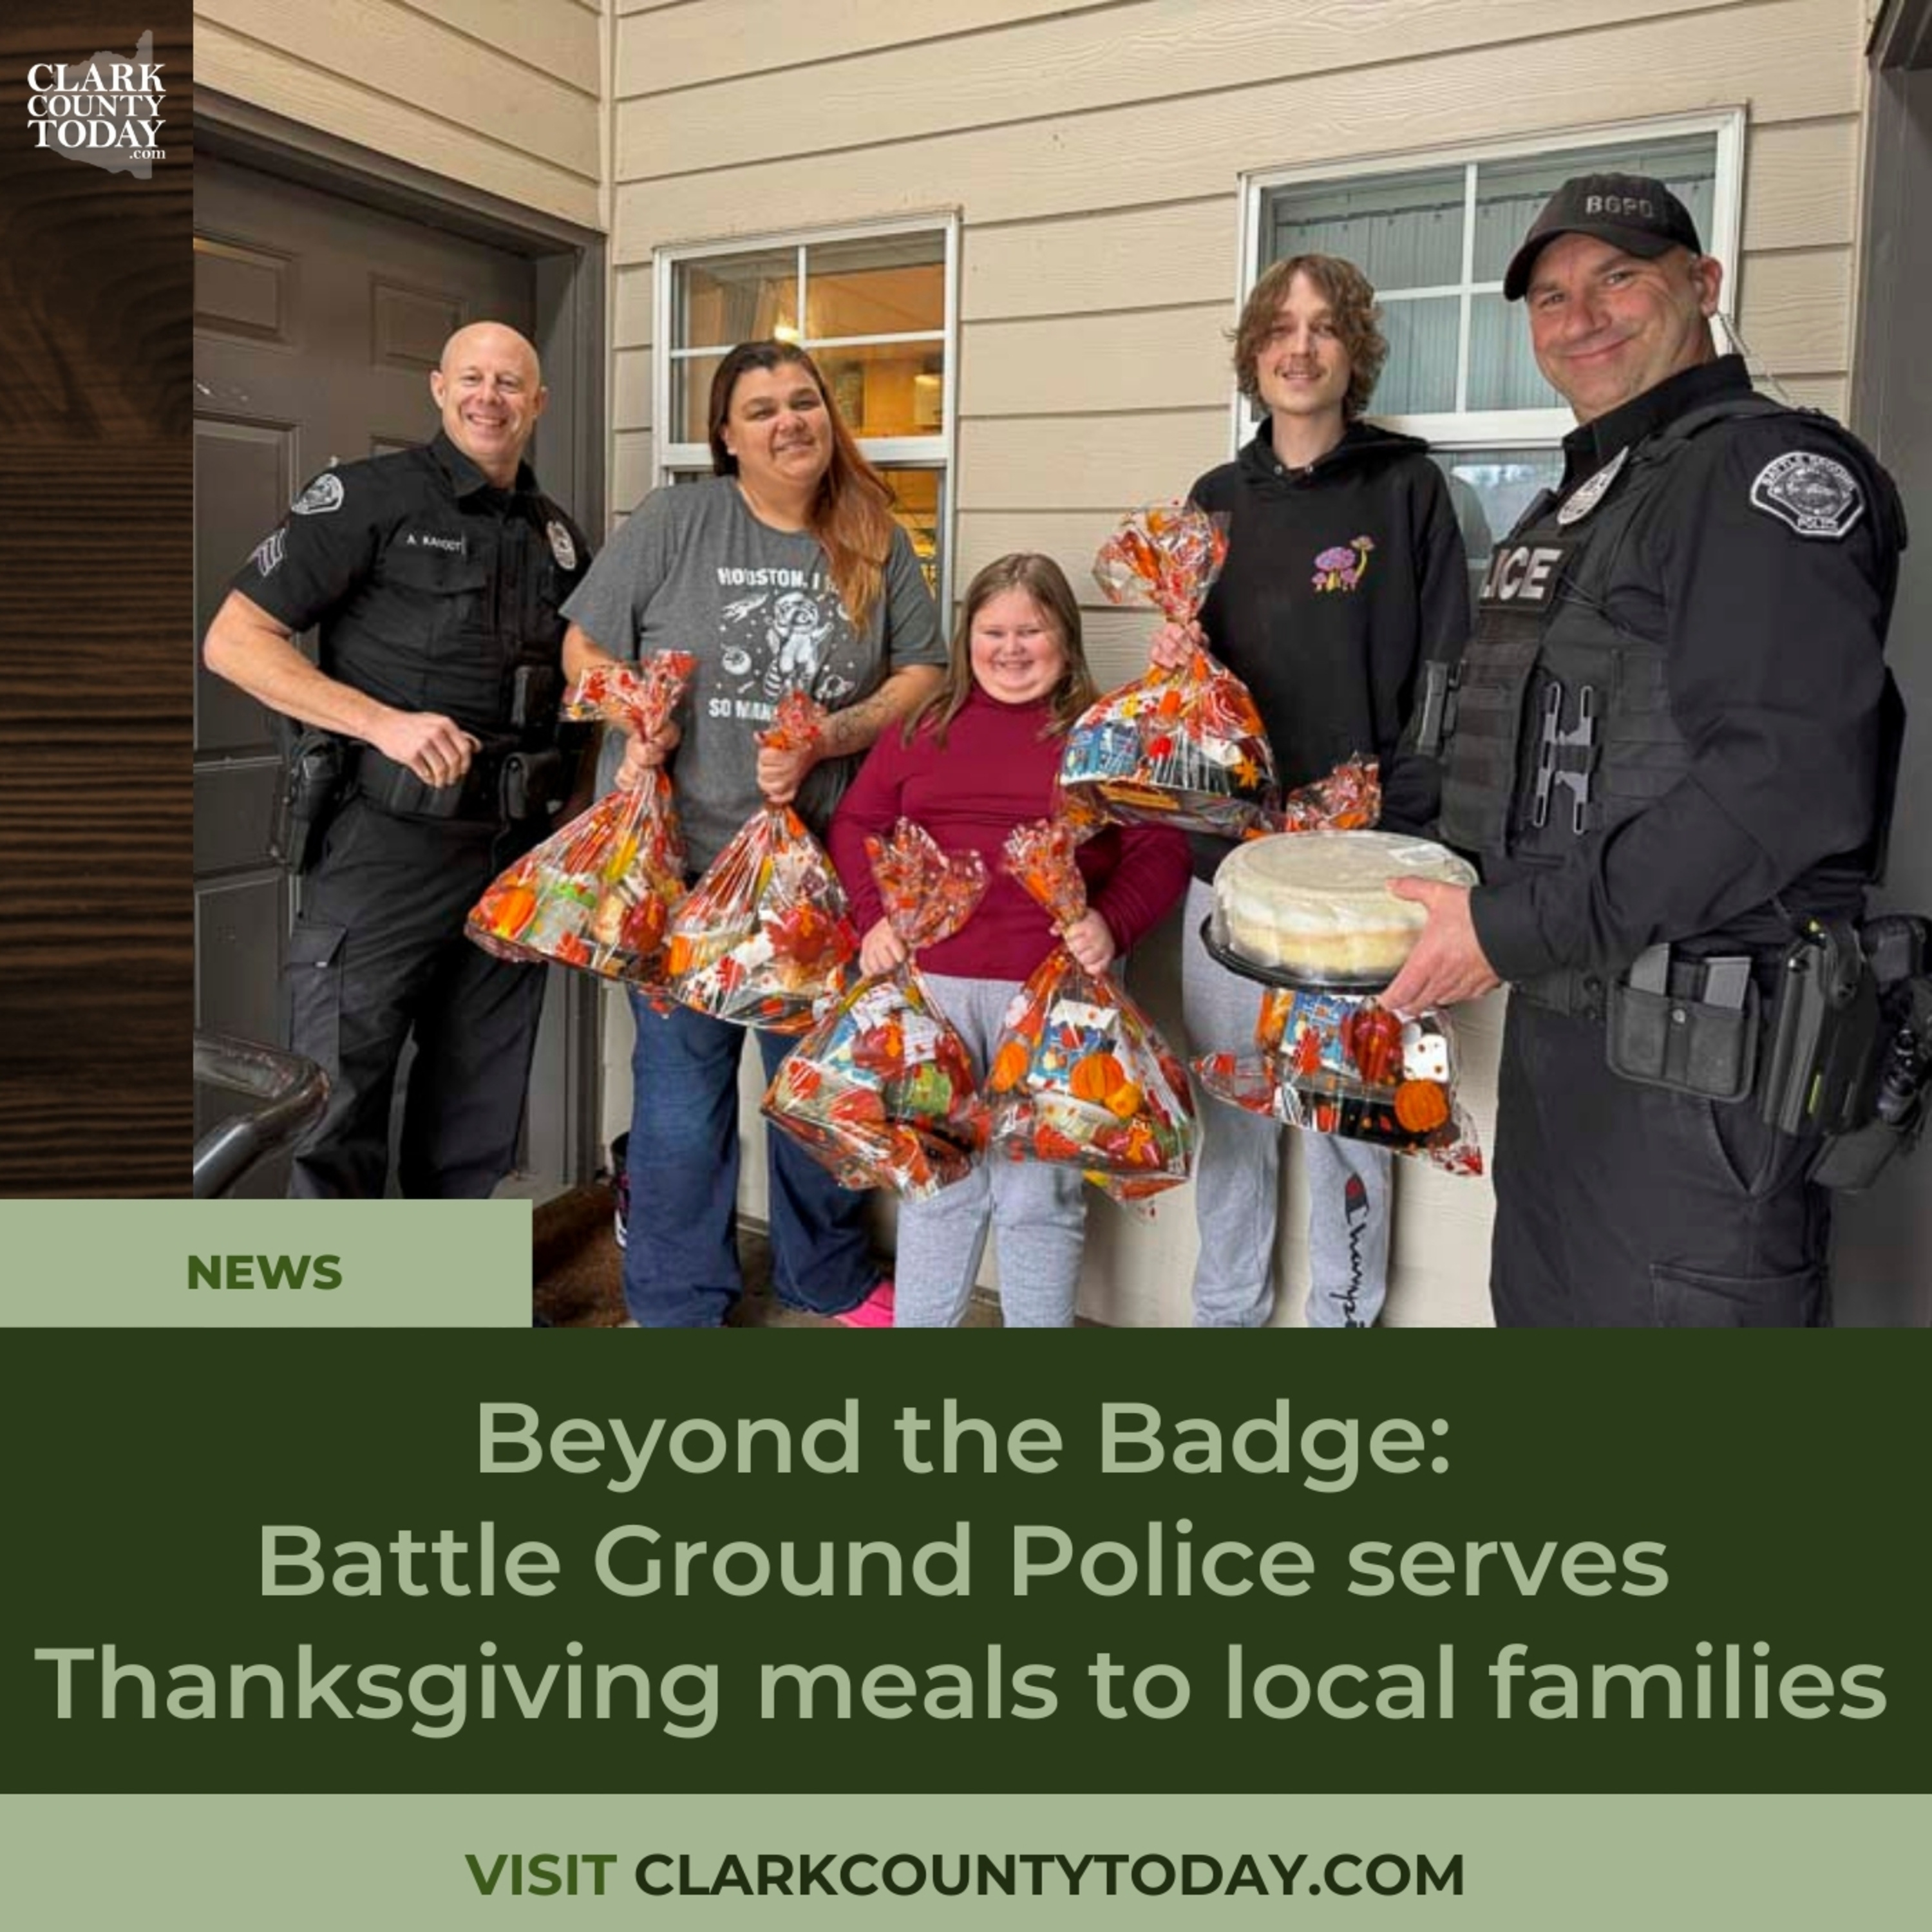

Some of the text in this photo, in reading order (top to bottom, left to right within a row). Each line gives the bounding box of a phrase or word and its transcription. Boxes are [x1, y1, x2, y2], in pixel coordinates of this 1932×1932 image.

[812, 572, 820, 590] I
[1479, 546, 1563, 600] ICE
[708, 697, 772, 721] SO MAN
